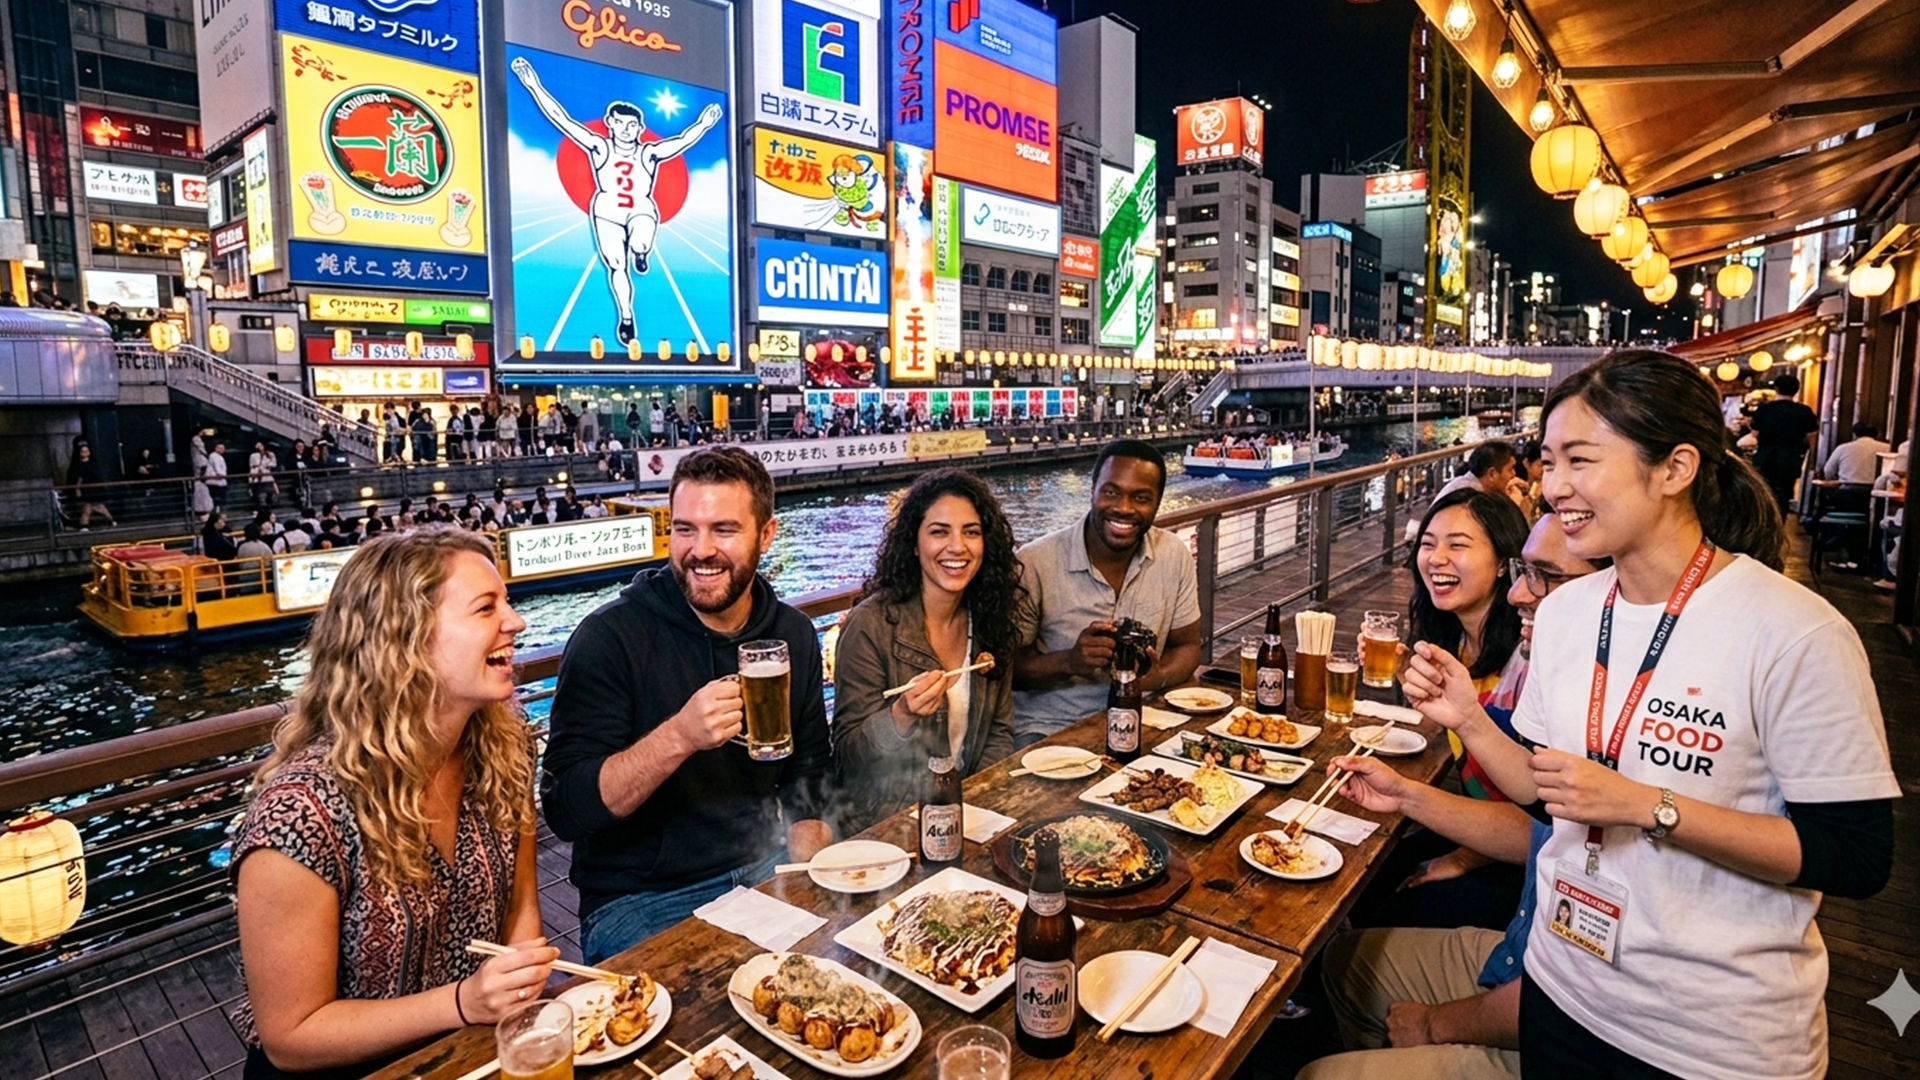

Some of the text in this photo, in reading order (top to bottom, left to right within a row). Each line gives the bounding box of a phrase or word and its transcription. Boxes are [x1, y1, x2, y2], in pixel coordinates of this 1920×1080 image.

[562, 0, 682, 50] Glico
[635, 0, 671, 19] 1935
[764, 252, 881, 304] CHINTAI
[1647, 698, 1726, 730] OSAKA
[1639, 717, 1724, 753] FOOD
[1638, 740, 1714, 777] TOUR
